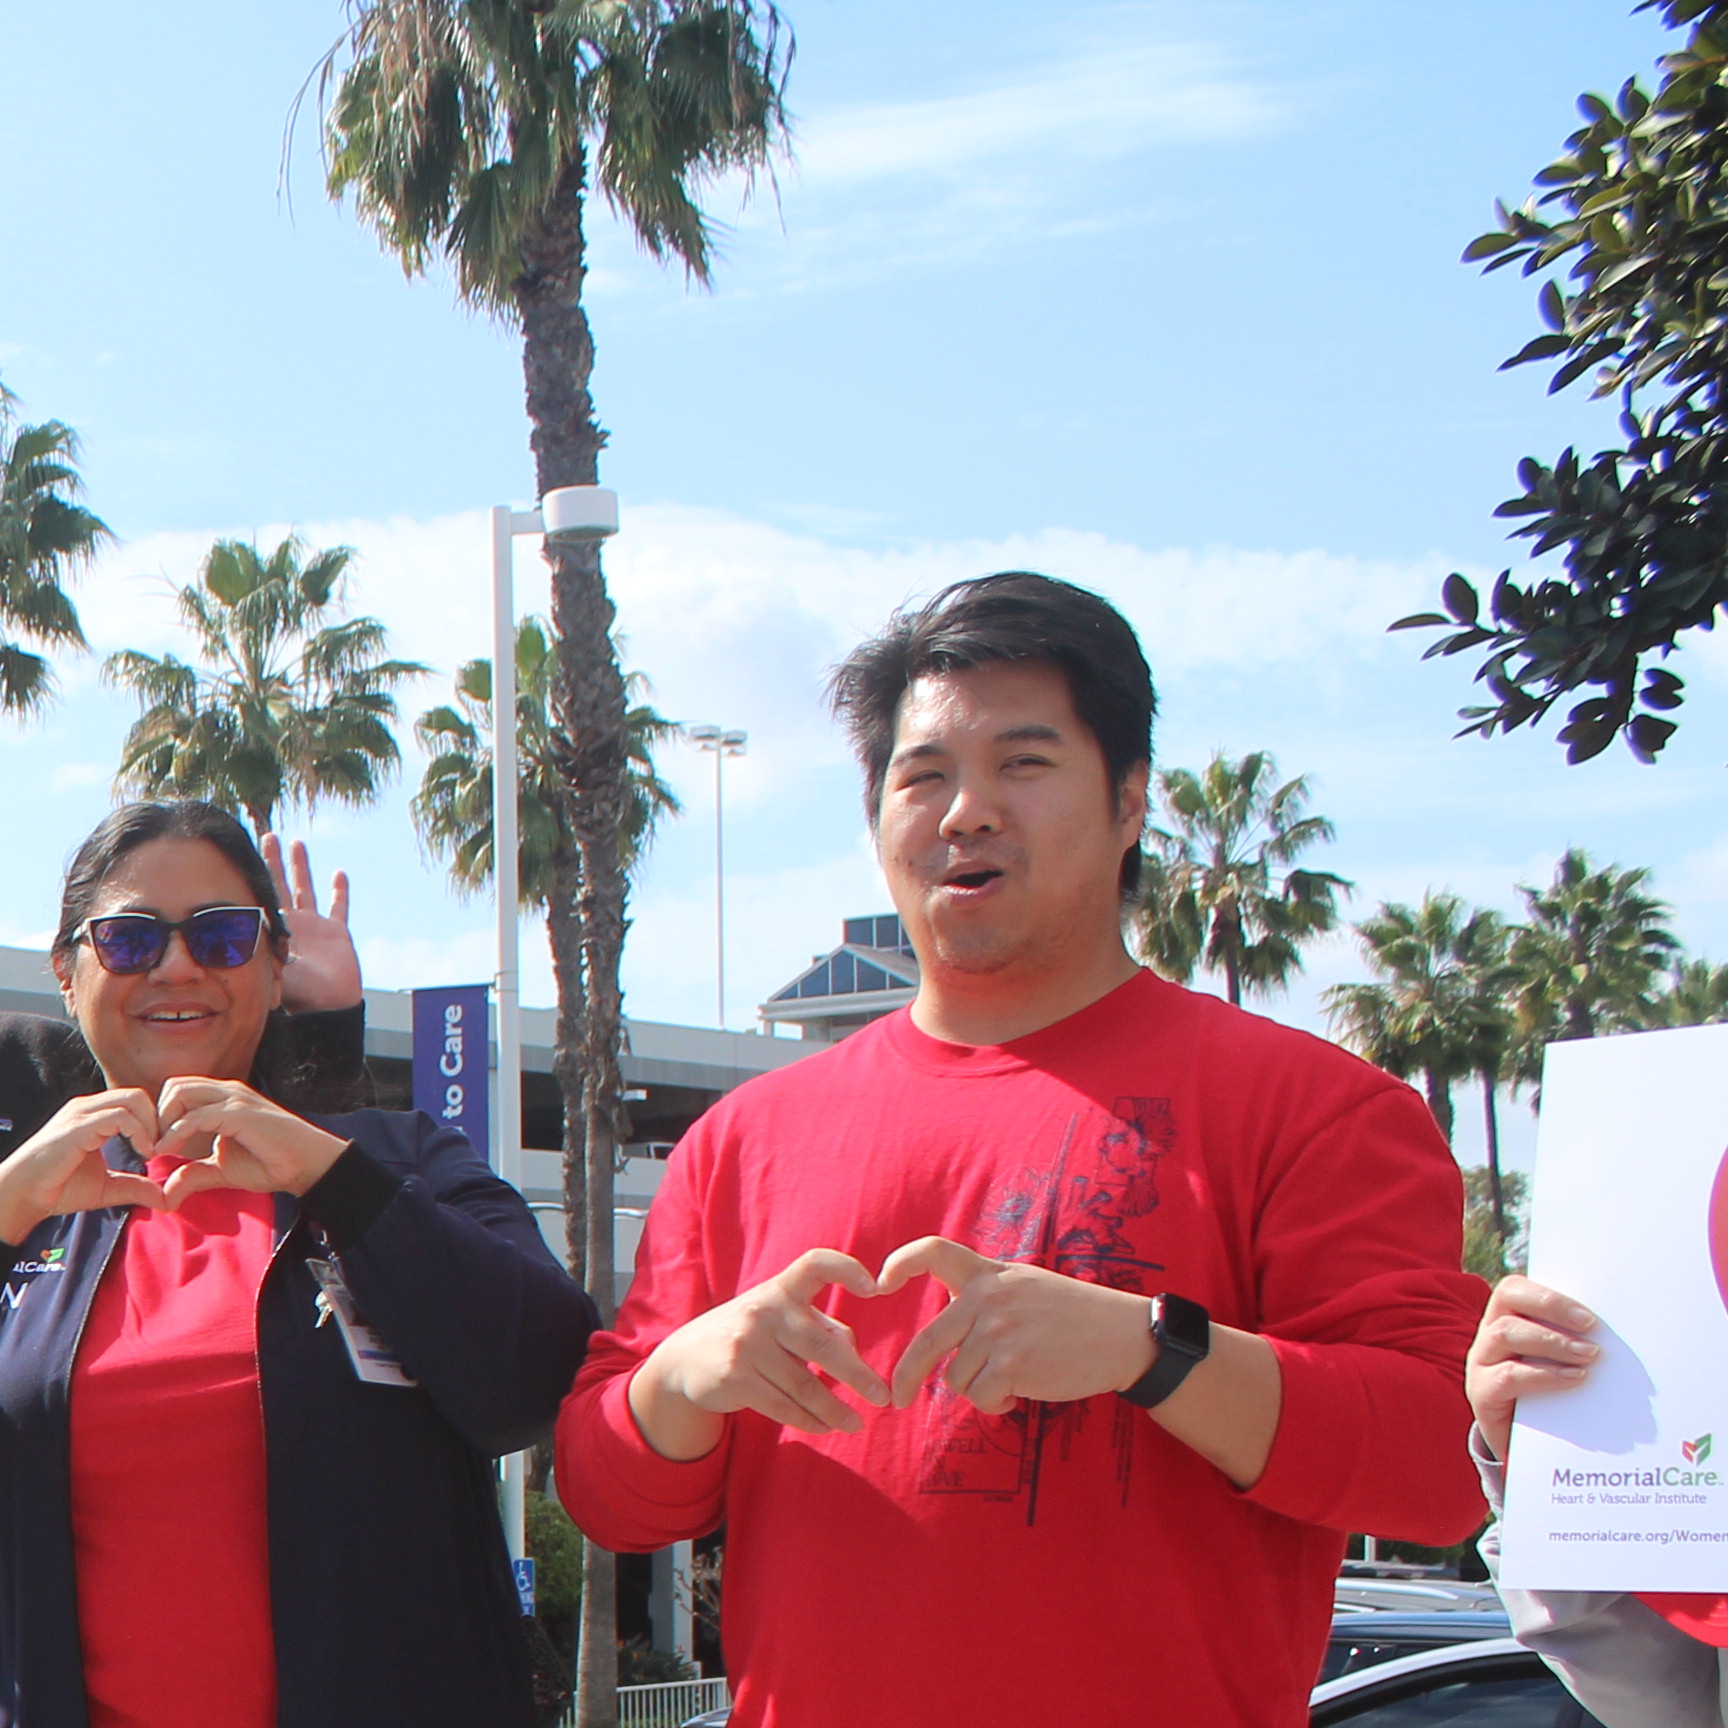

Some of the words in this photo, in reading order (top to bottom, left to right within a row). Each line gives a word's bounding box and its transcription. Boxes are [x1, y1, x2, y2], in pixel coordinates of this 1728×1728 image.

[440, 1004, 463, 1077] Care
[442, 1084, 463, 1119] to
[0, 1282, 29, 1309] N
[1552, 1467, 1718, 1488] MemorialCare
[1551, 1493, 1584, 1505] Heart
[1587, 1493, 1595, 1505] &
[1599, 1493, 1652, 1505] Vascular
[1655, 1493, 1707, 1505] Institute
